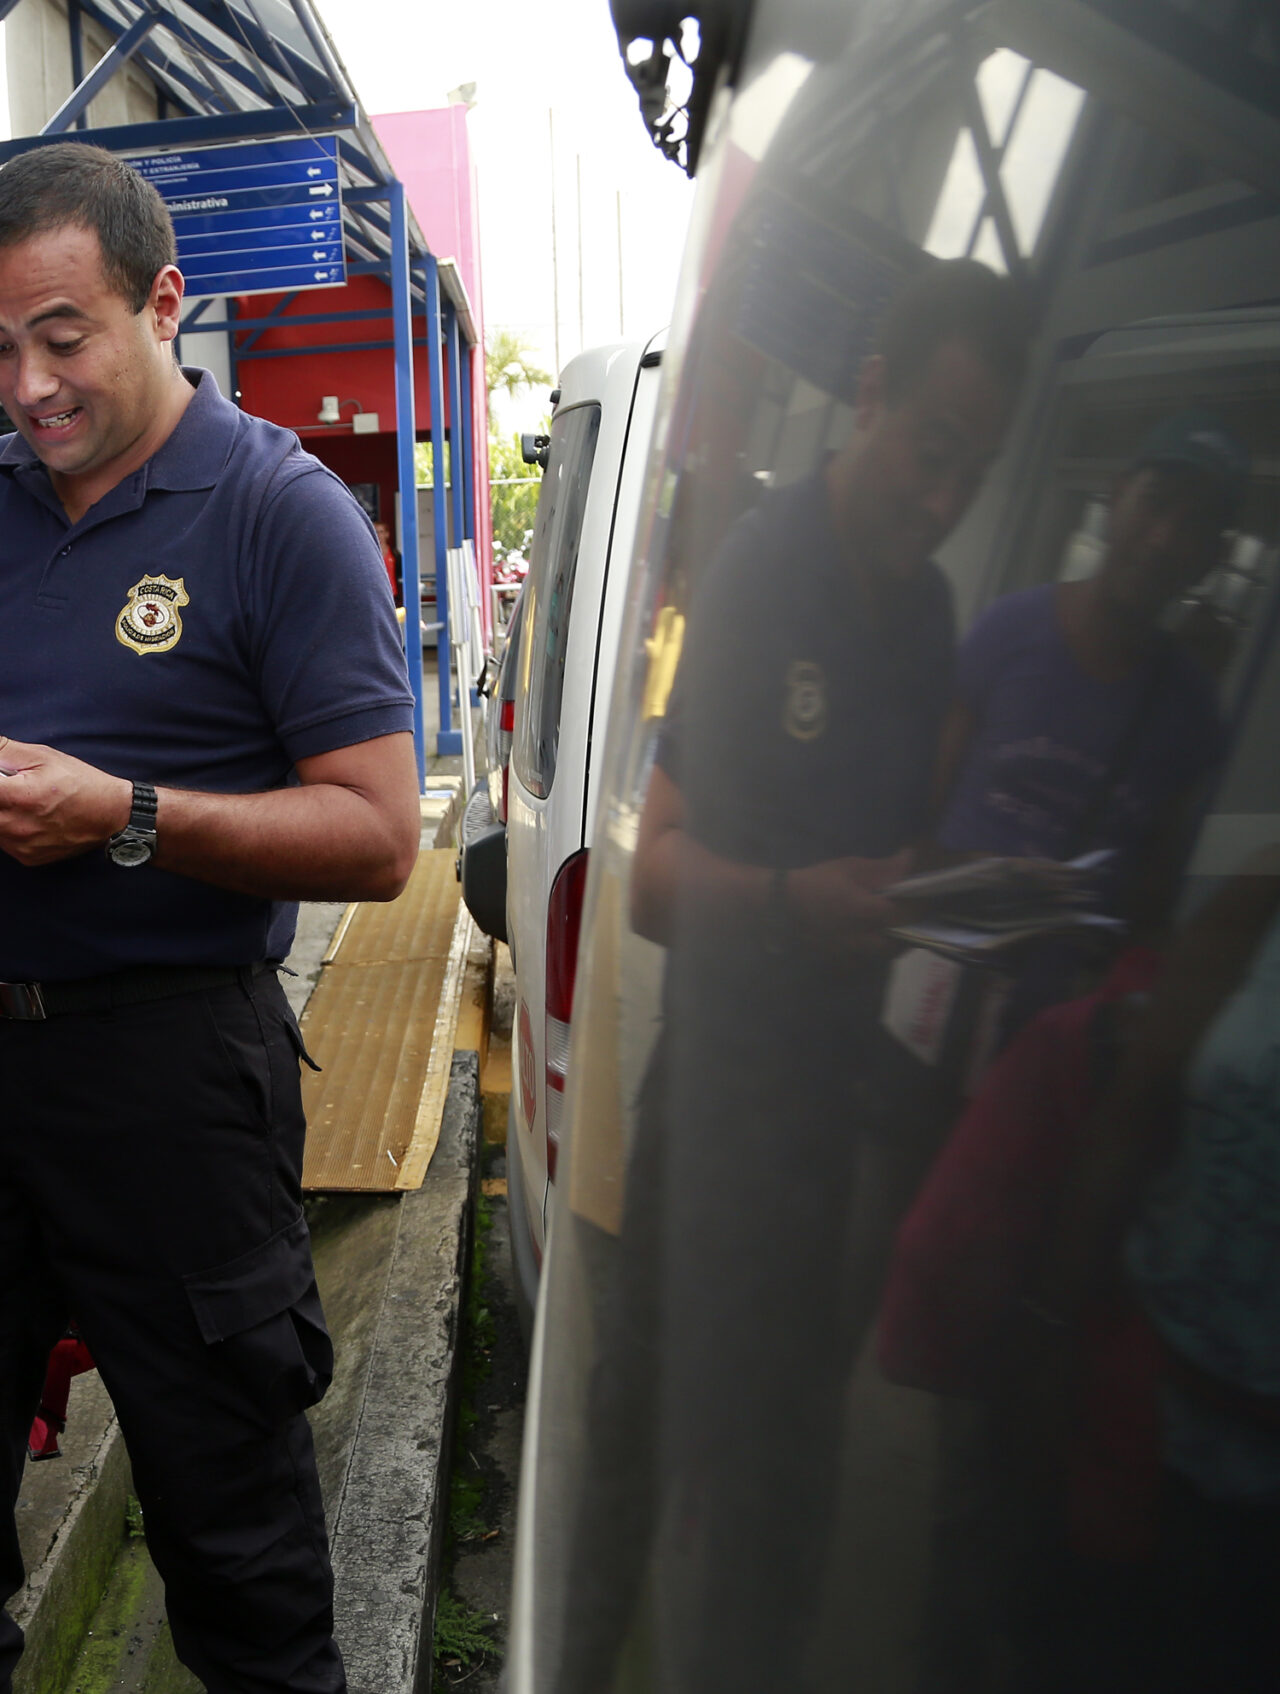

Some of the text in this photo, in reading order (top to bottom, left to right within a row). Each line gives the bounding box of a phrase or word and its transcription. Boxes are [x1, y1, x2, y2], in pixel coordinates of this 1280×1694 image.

[166, 197, 228, 211] ministrativa
[140, 585, 175, 600] COSTA RICA
